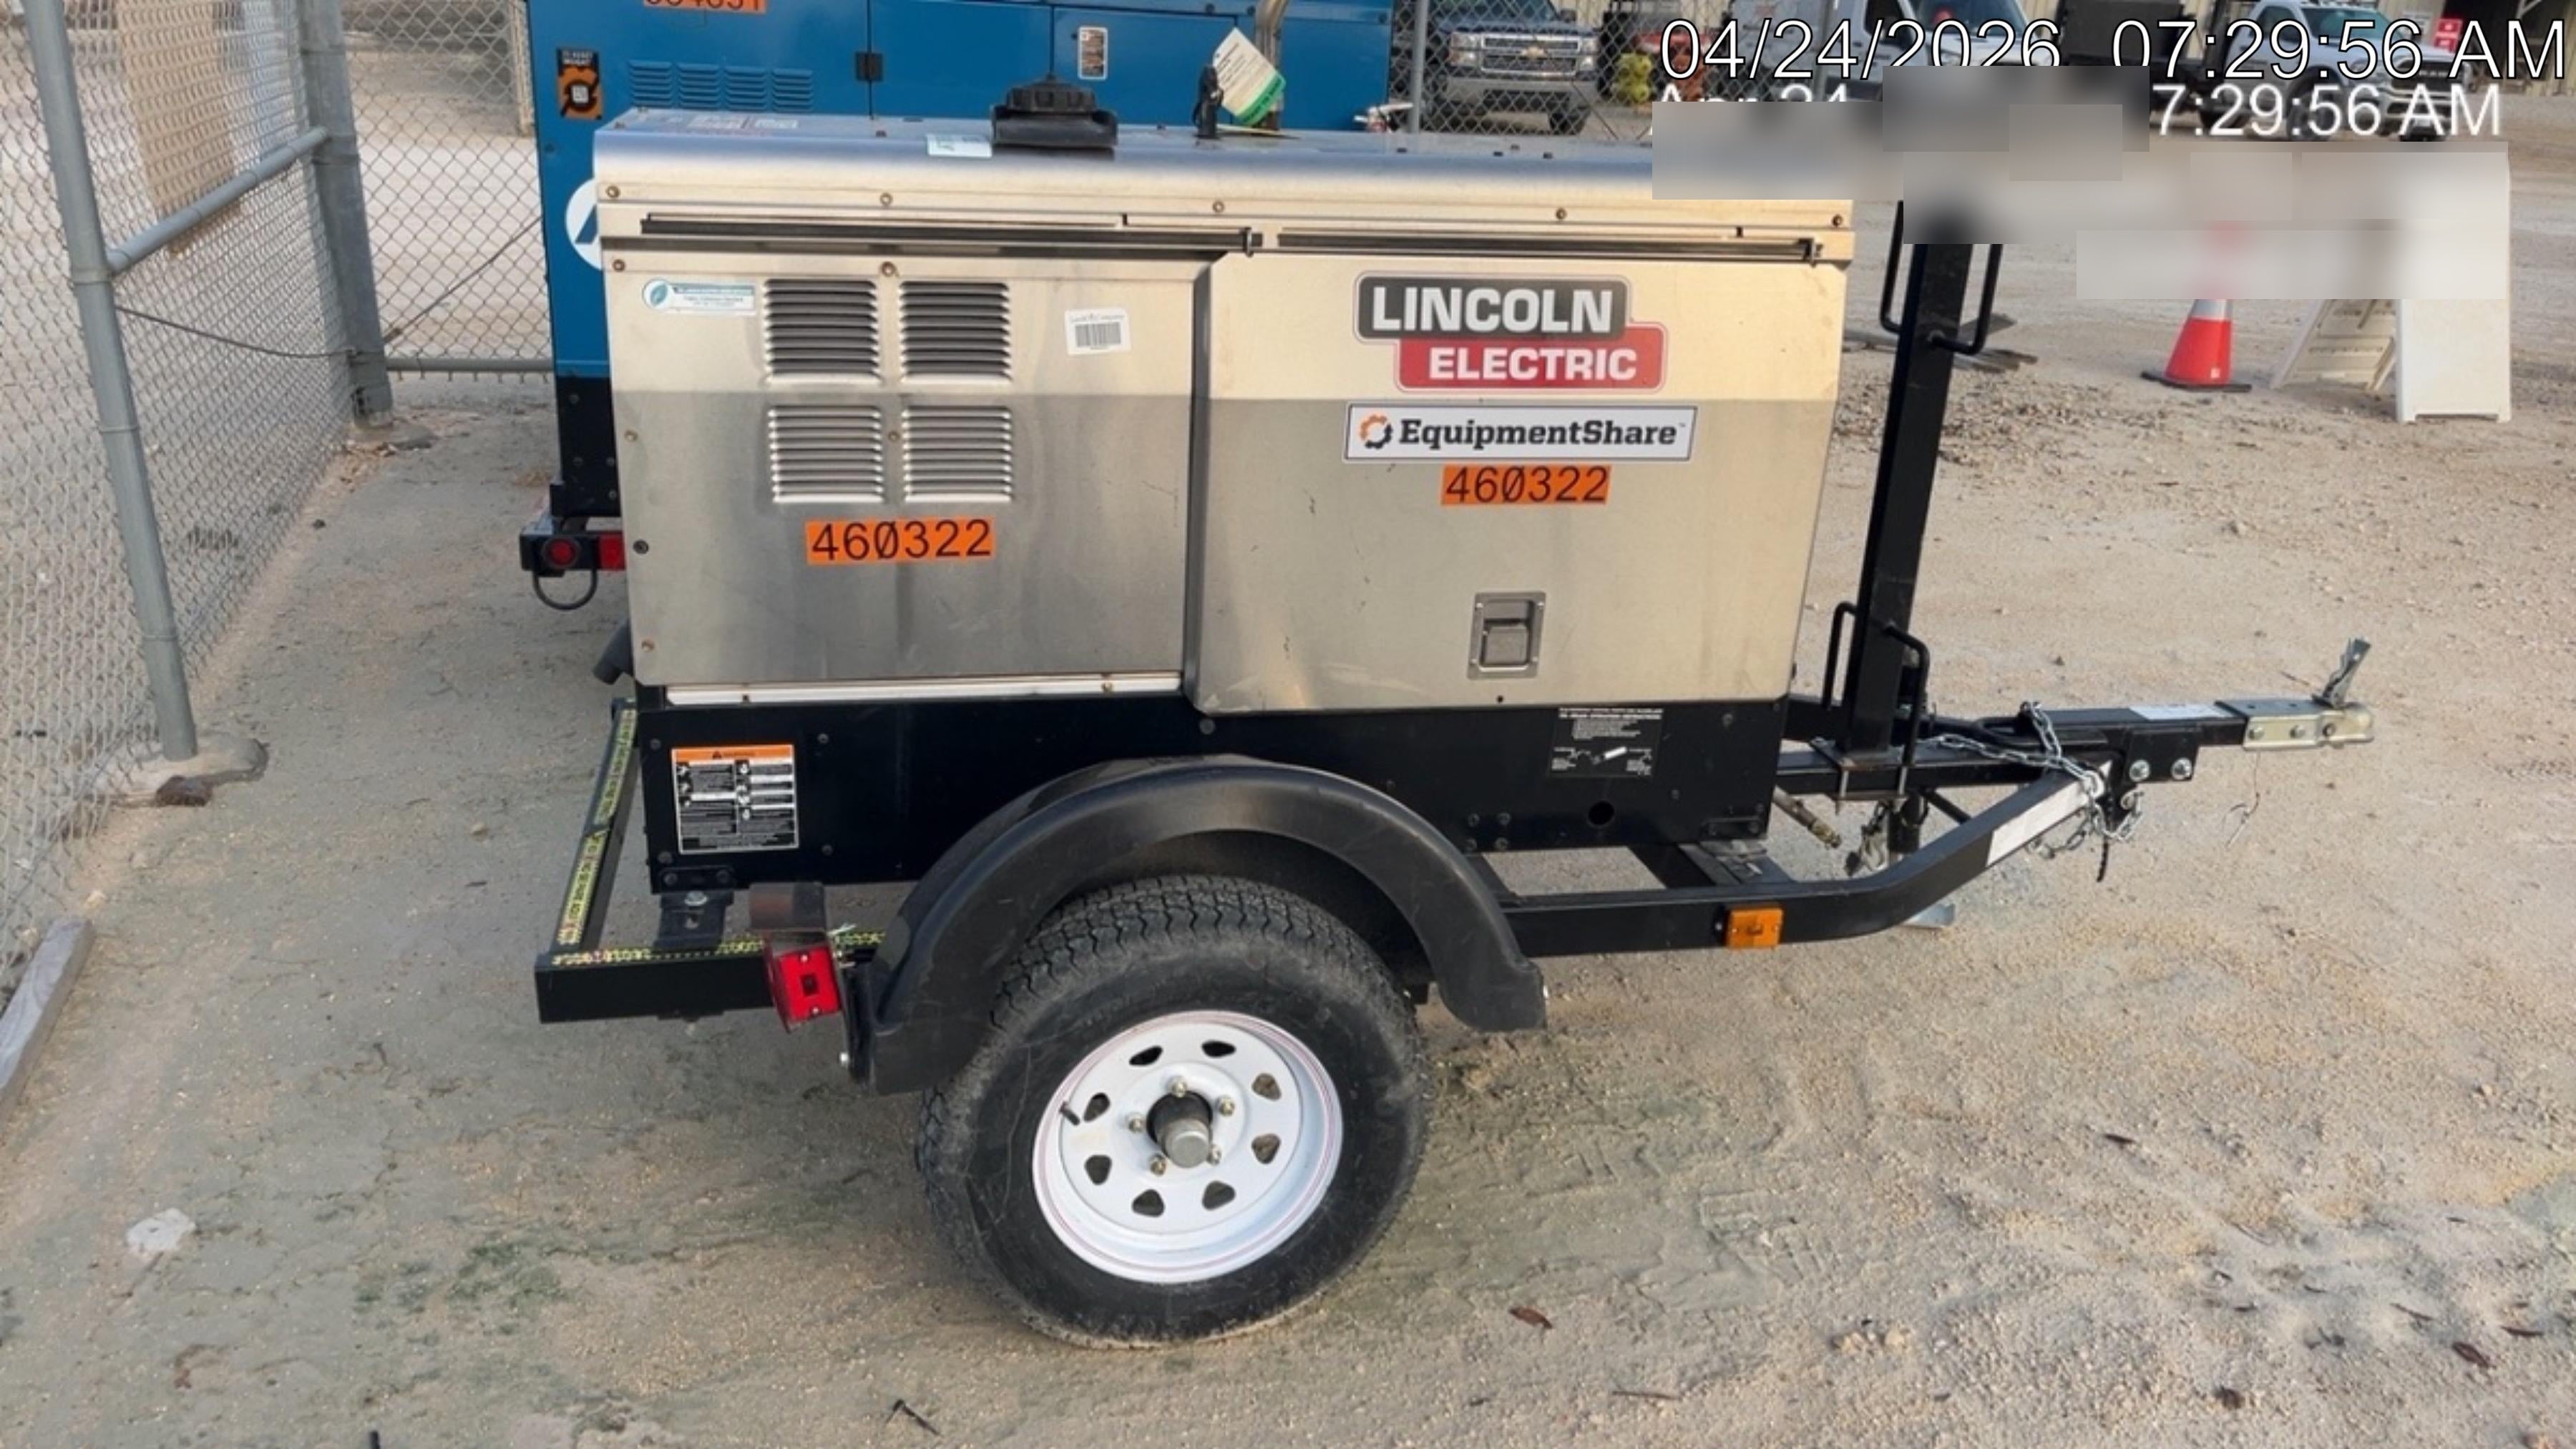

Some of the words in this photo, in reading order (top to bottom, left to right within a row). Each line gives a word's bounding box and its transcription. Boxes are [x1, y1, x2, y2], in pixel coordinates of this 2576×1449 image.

[1372, 286, 1613, 333] LINCOLN
[1429, 347, 1638, 381] ELECTRIC
[1400, 419, 1677, 450] EquipmentShare
[1445, 466, 1609, 502] 460322
[812, 519, 991, 560] 460322
